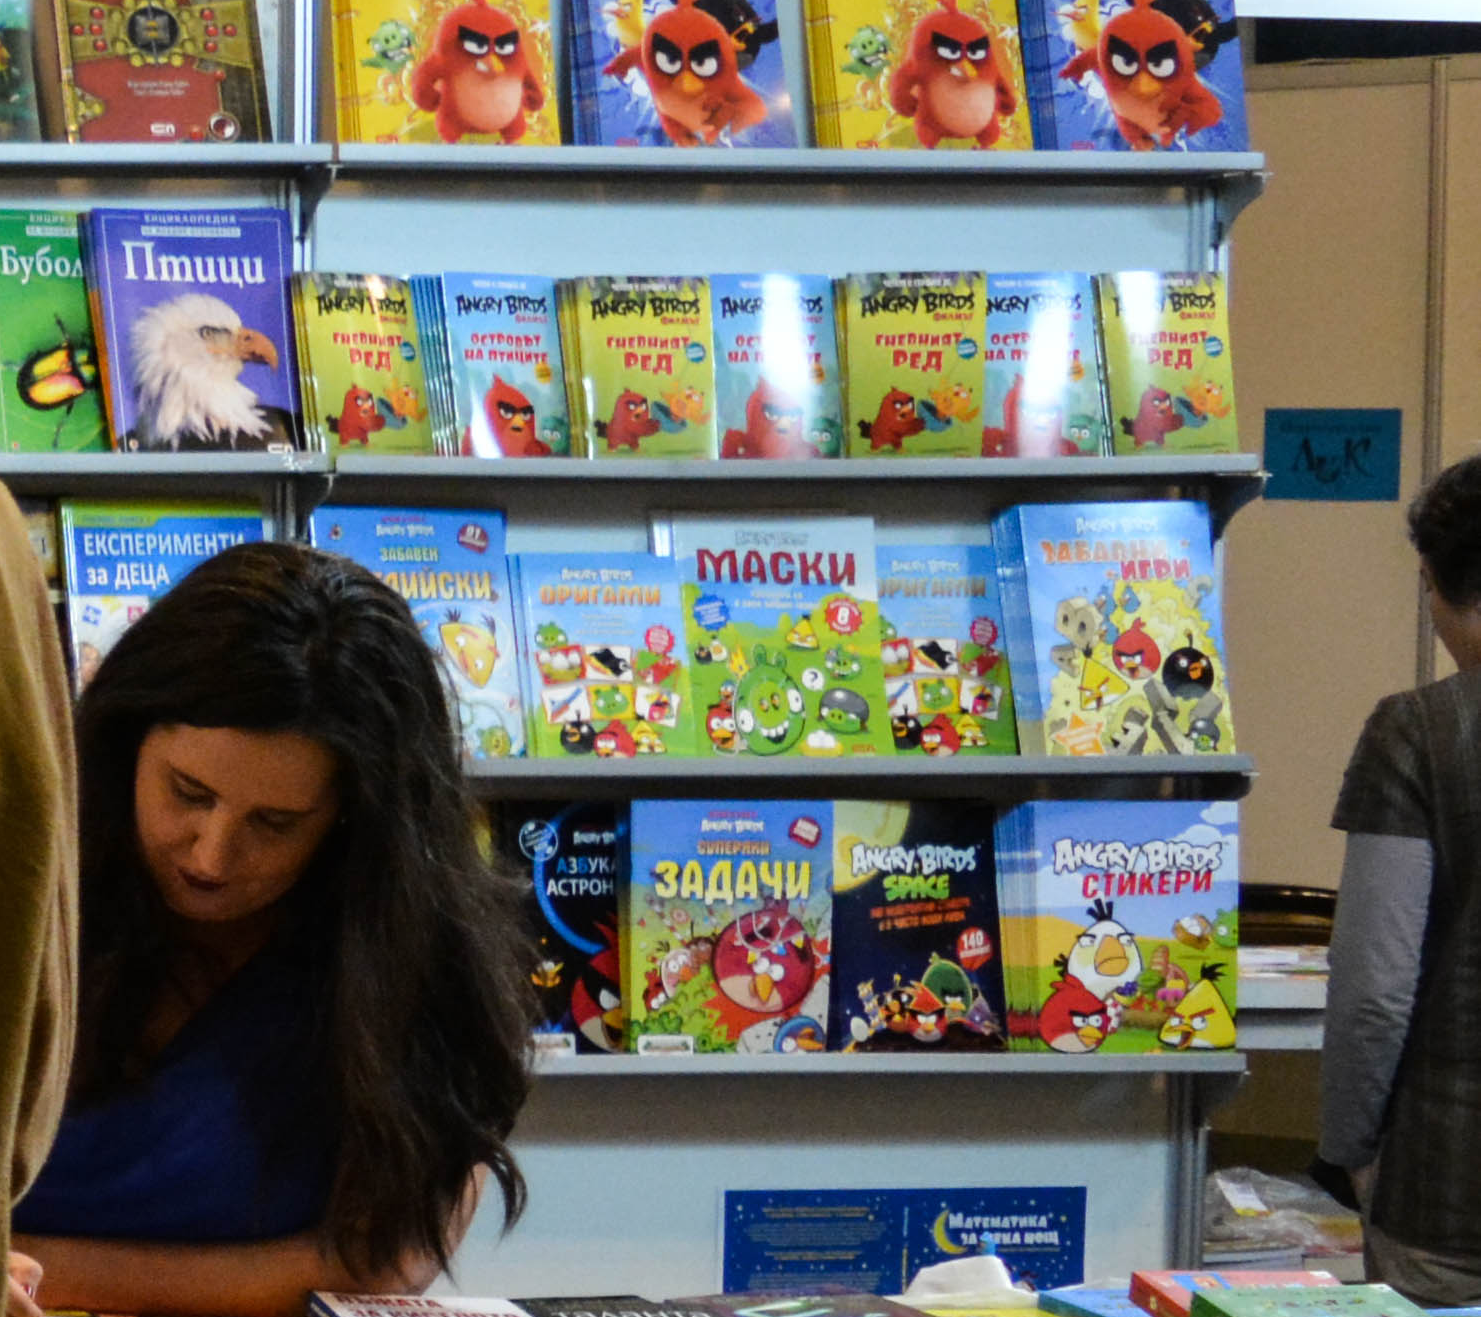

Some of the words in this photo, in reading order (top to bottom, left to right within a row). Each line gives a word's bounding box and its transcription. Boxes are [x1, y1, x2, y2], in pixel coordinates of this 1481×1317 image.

[144, 214, 236, 224] ЕНЦИКЛОПЕДИЯ
[0, 244, 84, 284] Бубол
[121, 240, 265, 288] Птици
[457, 296, 503, 317] ANGRY
[506, 296, 548, 315] BIRDS
[592, 297, 647, 320] ANGRY
[650, 297, 700, 317] BIRDS
[860, 296, 919, 318] ANGRY
[924, 293, 975, 316] BIRDS
[1170, 294, 1216, 317] BIRDS
[471, 333, 542, 346] ОСТРОВЪТ
[350, 348, 391, 372] РЕД
[624, 353, 673, 375] РЕД
[892, 349, 942, 372] РЕД
[1148, 348, 1194, 370] РЕД
[380, 547, 440, 563] ЗАБАВЕН
[1041, 540, 1166, 564] ЗАБАВНИ
[87, 569, 108, 585] за
[115, 563, 171, 589] ДЕЦА
[696, 548, 856, 586] МАСКИ
[1120, 557, 1192, 581] ИГРИ
[539, 586, 660, 605] ОРИГАМИ
[852, 844, 915, 877] ANGRY
[918, 844, 977, 875] BIRDS
[1053, 838, 1139, 874] ANGRY
[1141, 839, 1224, 872] BIRDS
[546, 879, 614, 896] АСТРОН
[654, 860, 810, 906] ЗАДАЧИ
[883, 874, 950, 901] SPACE
[1082, 869, 1213, 899] СТИКЕРИ
[962, 930, 984, 948] 140
